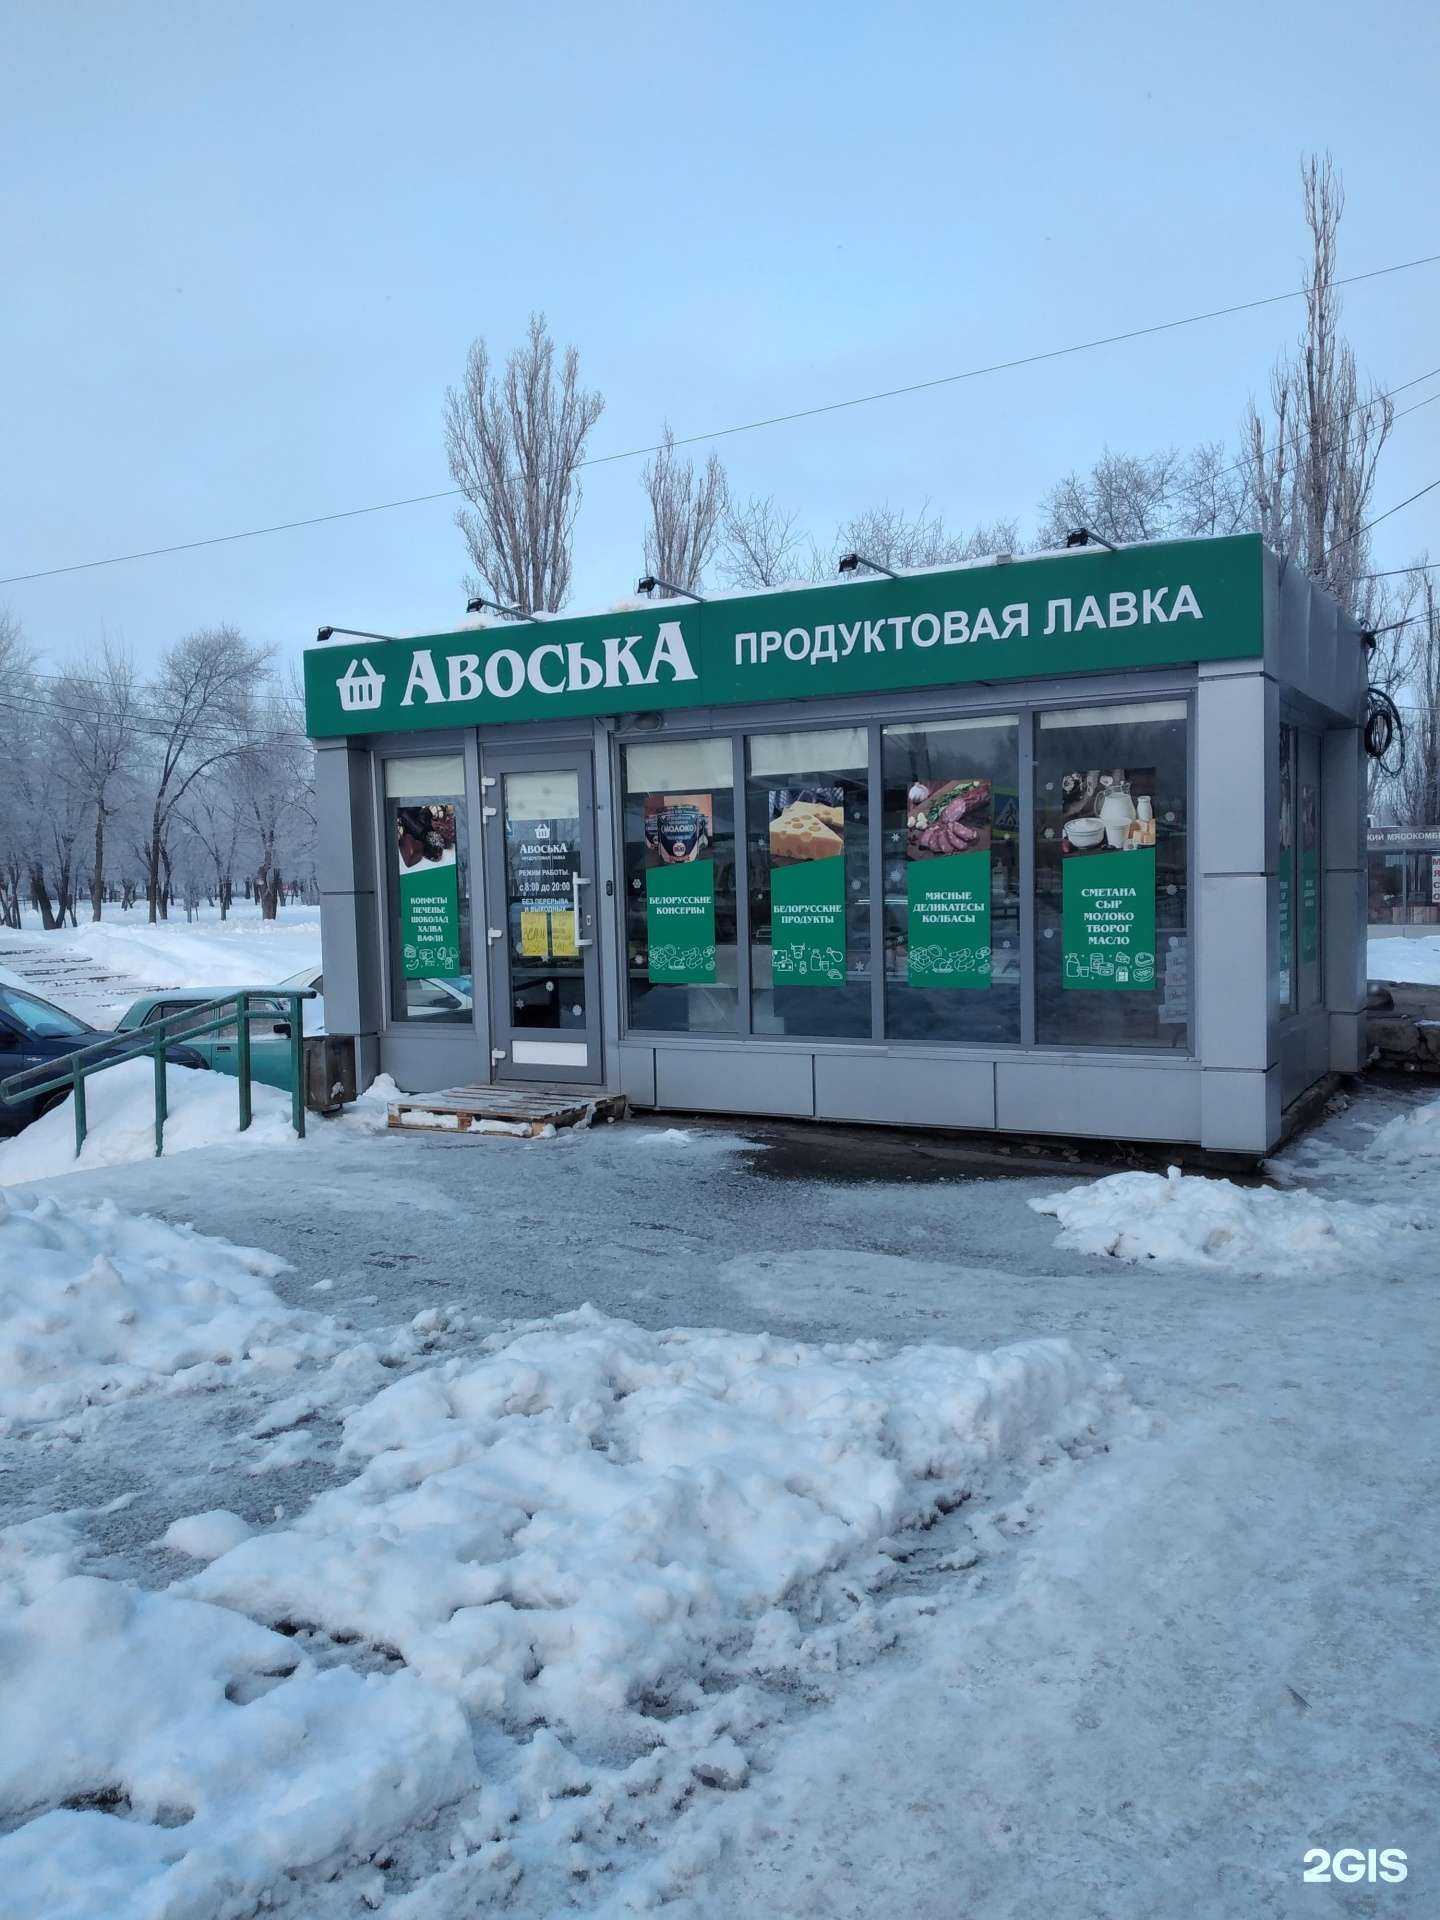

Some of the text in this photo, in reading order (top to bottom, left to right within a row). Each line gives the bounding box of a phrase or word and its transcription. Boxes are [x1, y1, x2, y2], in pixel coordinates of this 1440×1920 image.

[734, 584, 1204, 665] ПРОДУКТОВАЯ ЛАВКА
[400, 621, 698, 707] АВОСЬКА
[1387, 831, 1440, 840] МЯСОКОМБ
[520, 842, 568, 854] АВОСЬКА
[519, 869, 541, 877] РЕЖИМ
[541, 883, 551, 893] до
[552, 881, 571, 891] 20:00
[925, 891, 973, 900] МЯСНЫЕ
[1081, 887, 1137, 897] СМЕТАНА
[410, 896, 448, 905] КОНФЕТЫ
[648, 896, 712, 905] БЕЛОРУССКИЕ
[1095, 900, 1122, 909] СЫР
[412, 906, 446, 914] ПЕЧЕНЬЕ
[656, 906, 705, 915] КОНСЕРВЫ
[773, 904, 842, 913] БЕЛОРУССКИЕ
[912, 903, 985, 913] ДЕЛИКАТЕСЫ
[411, 916, 449, 924] ШОКОЛАД
[781, 915, 834, 924] ПРОДУКТЫ
[922, 914, 976, 923] КОЛБАСЫ
[1083, 912, 1135, 921] МОЛОКО
[418, 925, 442, 933] ХАЛВА
[1086, 924, 1132, 933] ТВОРОГ
[417, 934, 444, 942] ВАФЛИ
[1088, 936, 1130, 945] МАСЛО
